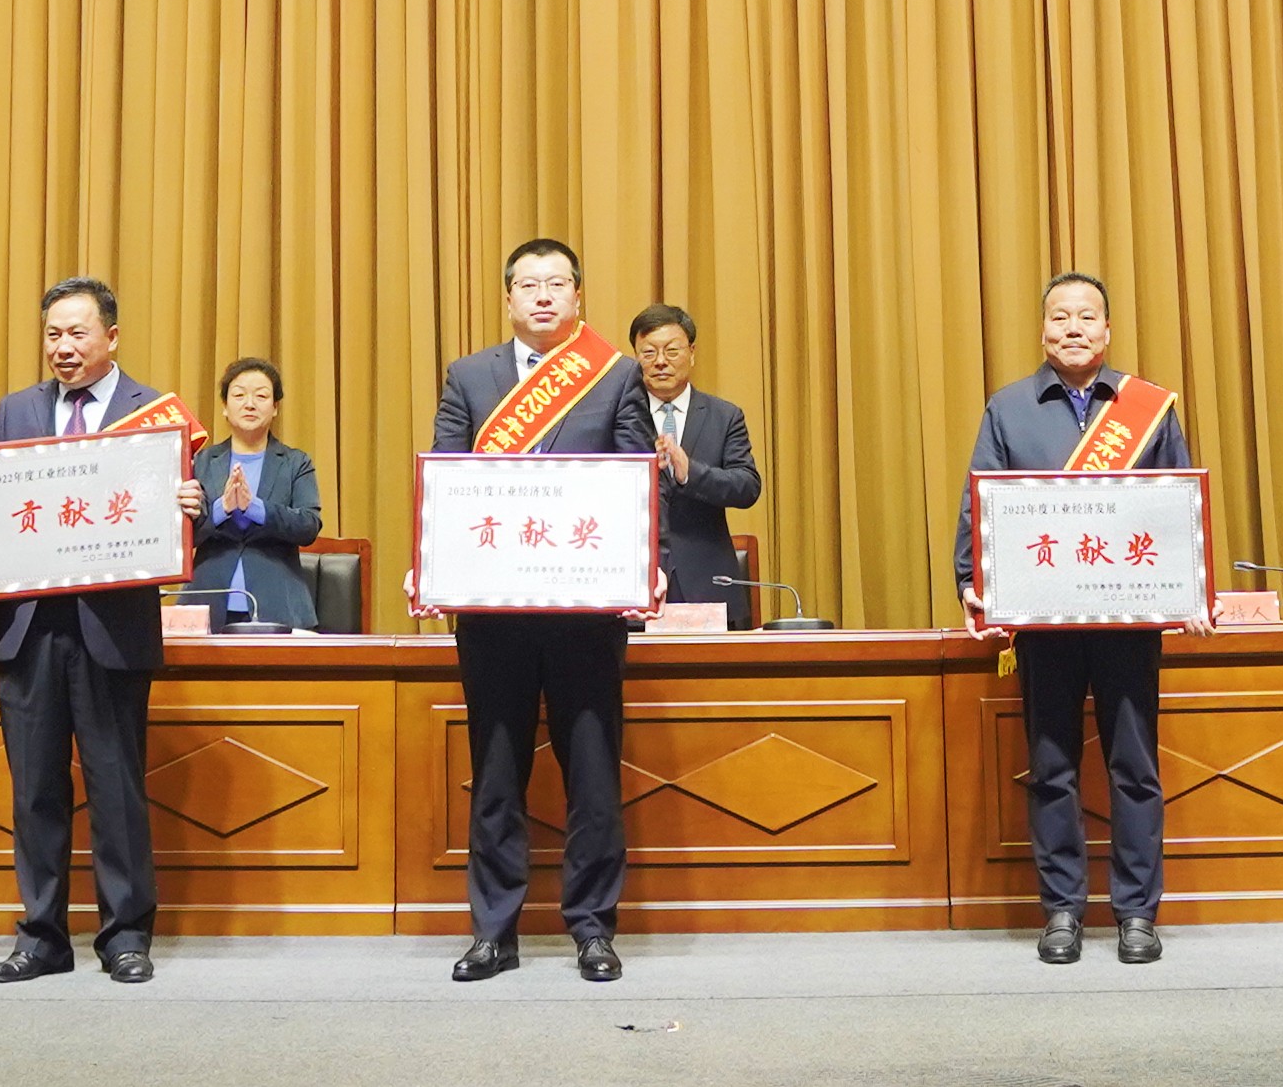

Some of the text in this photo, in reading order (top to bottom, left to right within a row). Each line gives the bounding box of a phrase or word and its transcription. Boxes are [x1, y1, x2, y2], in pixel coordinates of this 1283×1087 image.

[11, 489, 138, 534] 贡献奖
[1003, 502, 1117, 516] 2022年度工业经济发展
[469, 516, 603, 550] 贡献奖
[1026, 532, 1159, 568] 贡献奖
[1231, 604, 1269, 621] 持人
